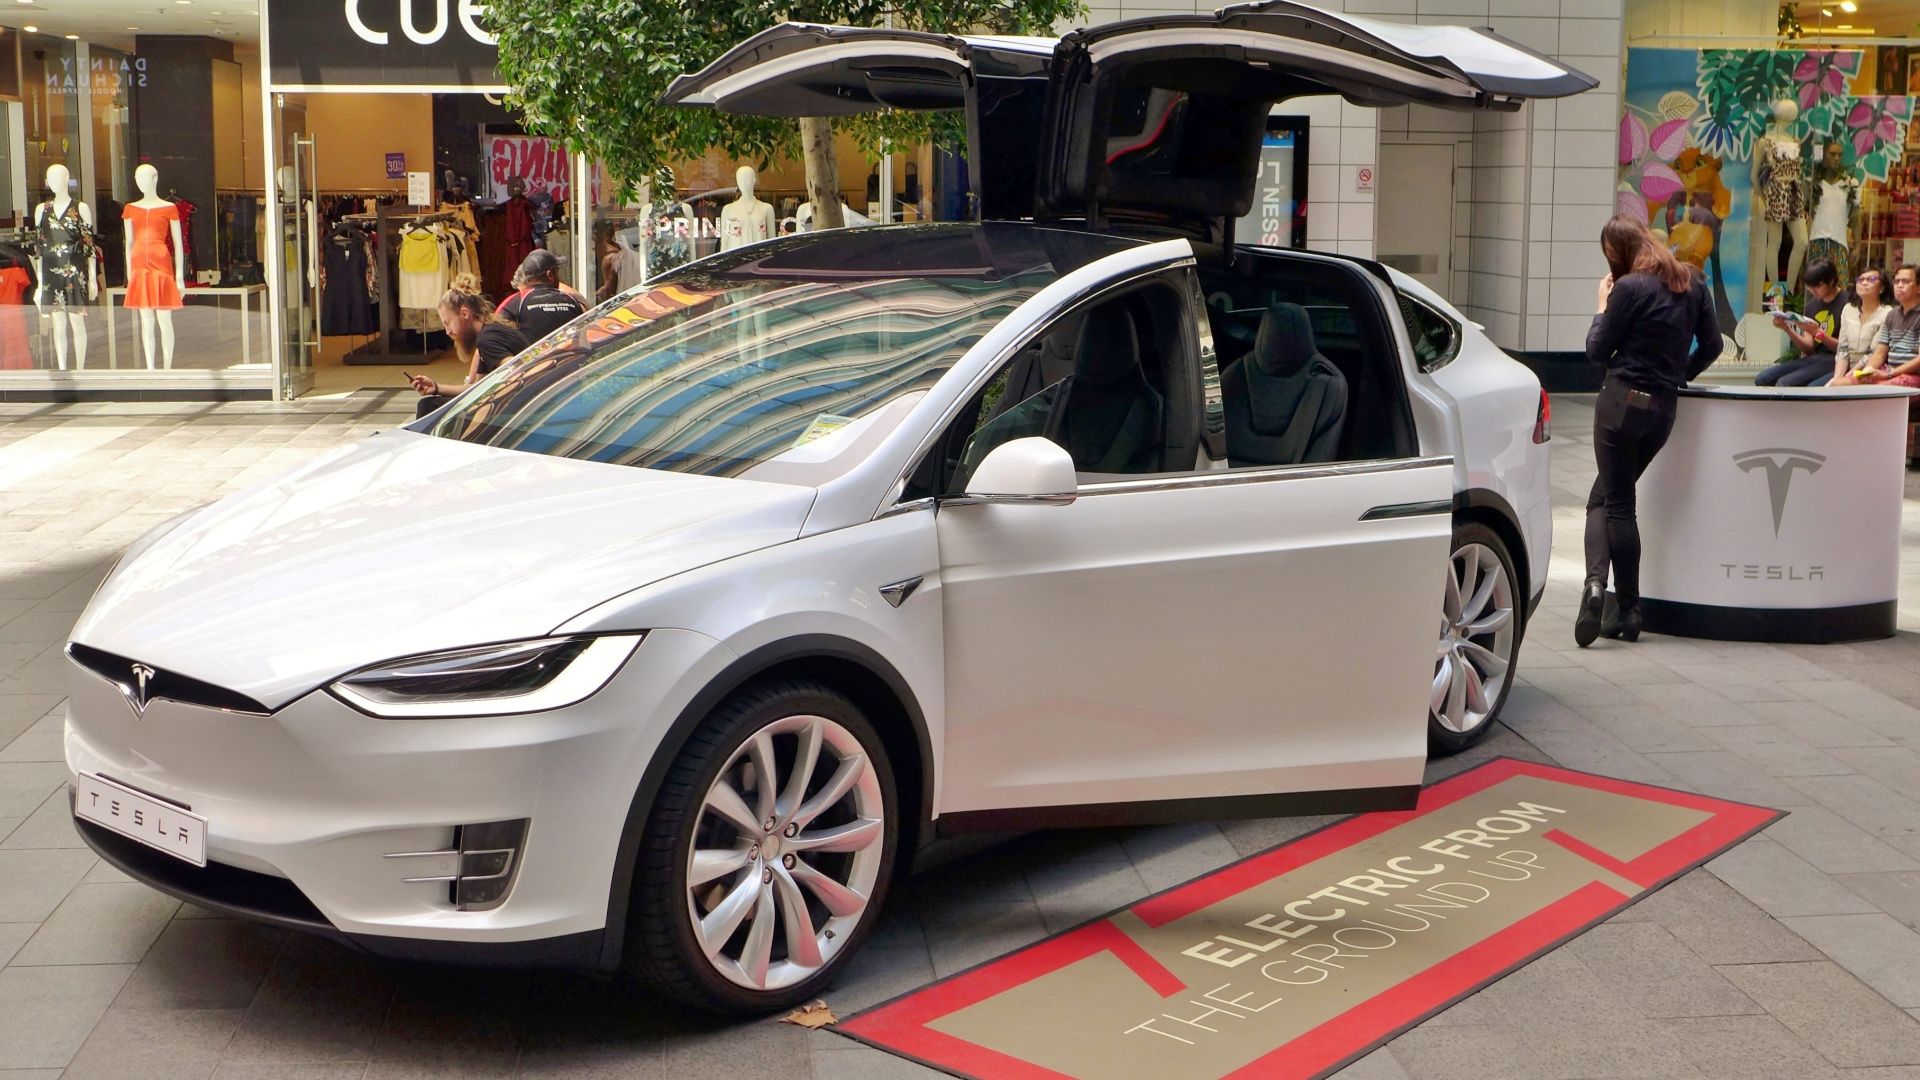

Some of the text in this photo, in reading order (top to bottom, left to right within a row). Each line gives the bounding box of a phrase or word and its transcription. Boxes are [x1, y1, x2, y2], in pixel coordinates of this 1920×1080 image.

[1720, 563, 1824, 581] TESLA
[90, 791, 189, 845] TESLA
[1181, 801, 1568, 969] ELECTRIC FROM
[1123, 850, 1546, 1046] THE GROUND UP
